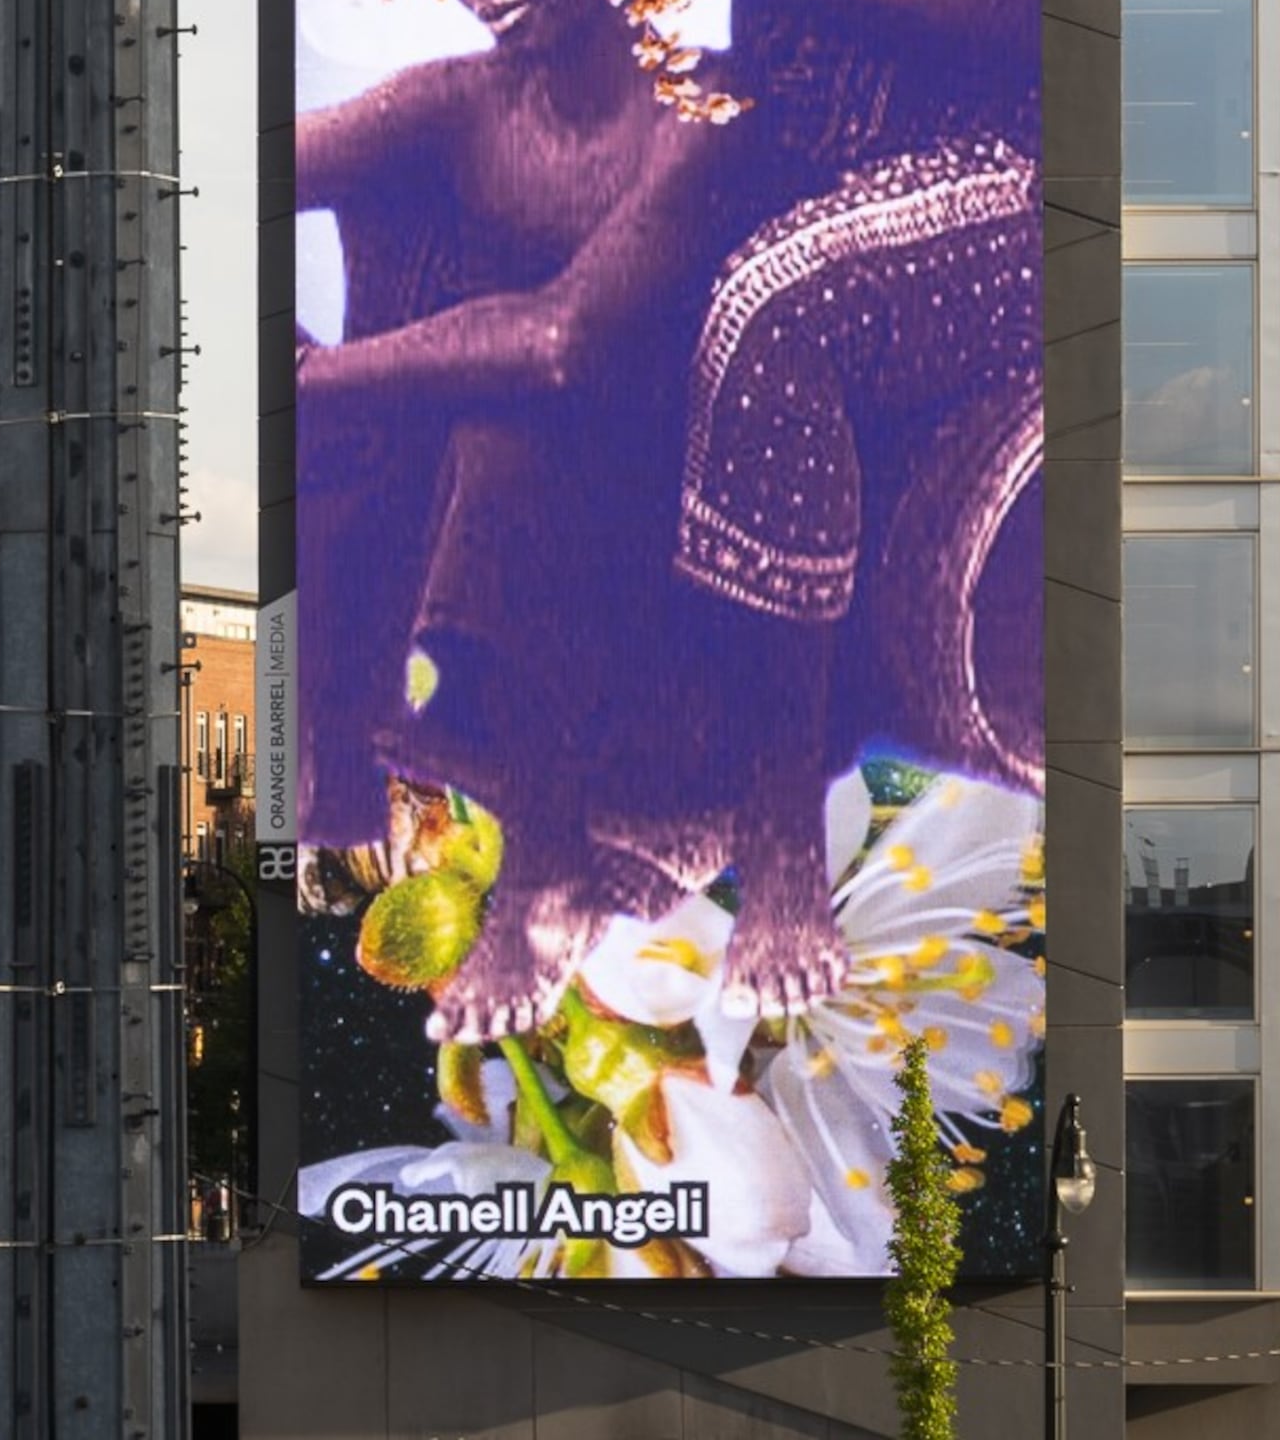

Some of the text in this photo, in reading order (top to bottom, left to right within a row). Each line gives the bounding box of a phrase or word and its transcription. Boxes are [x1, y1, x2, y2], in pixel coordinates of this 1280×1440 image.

[270, 612, 286, 829] ORANGE BARREL MEDIA
[332, 1187, 703, 1240] Chanell Angeli
